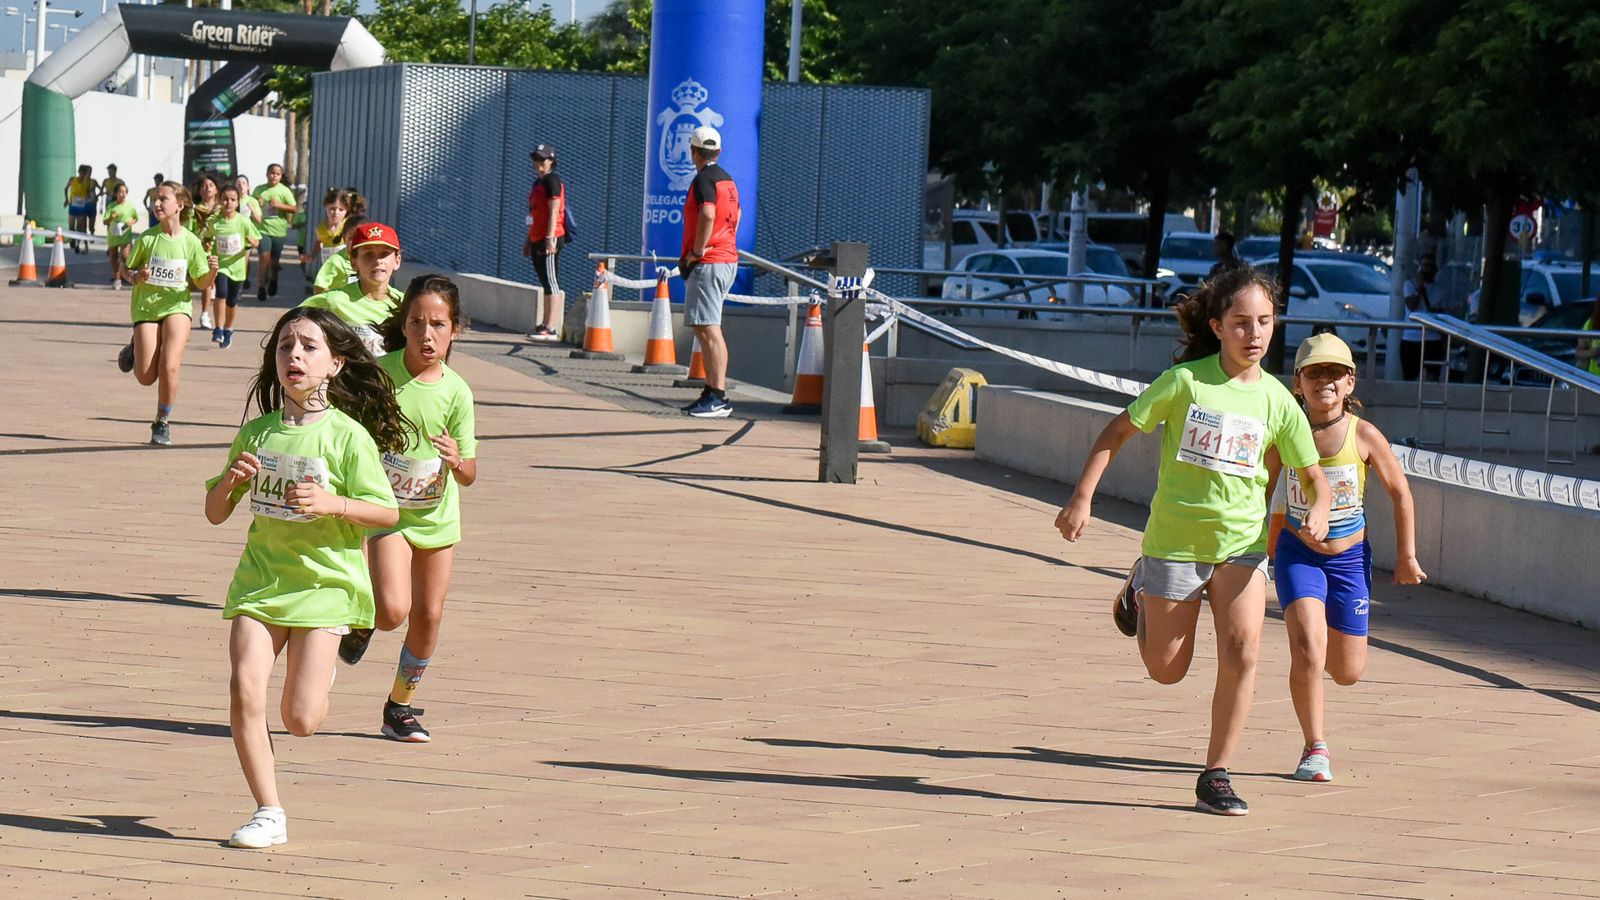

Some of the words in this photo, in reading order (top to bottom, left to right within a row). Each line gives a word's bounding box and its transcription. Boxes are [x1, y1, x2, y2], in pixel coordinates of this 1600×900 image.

[192, 20, 233, 43] Green
[237, 24, 276, 46] Rider
[644, 209, 684, 224] DEPO
[1512, 221, 1532, 233] 30
[150, 266, 174, 279] 1556
[1190, 409, 1206, 421] XXI
[1188, 427, 1234, 456] 1411
